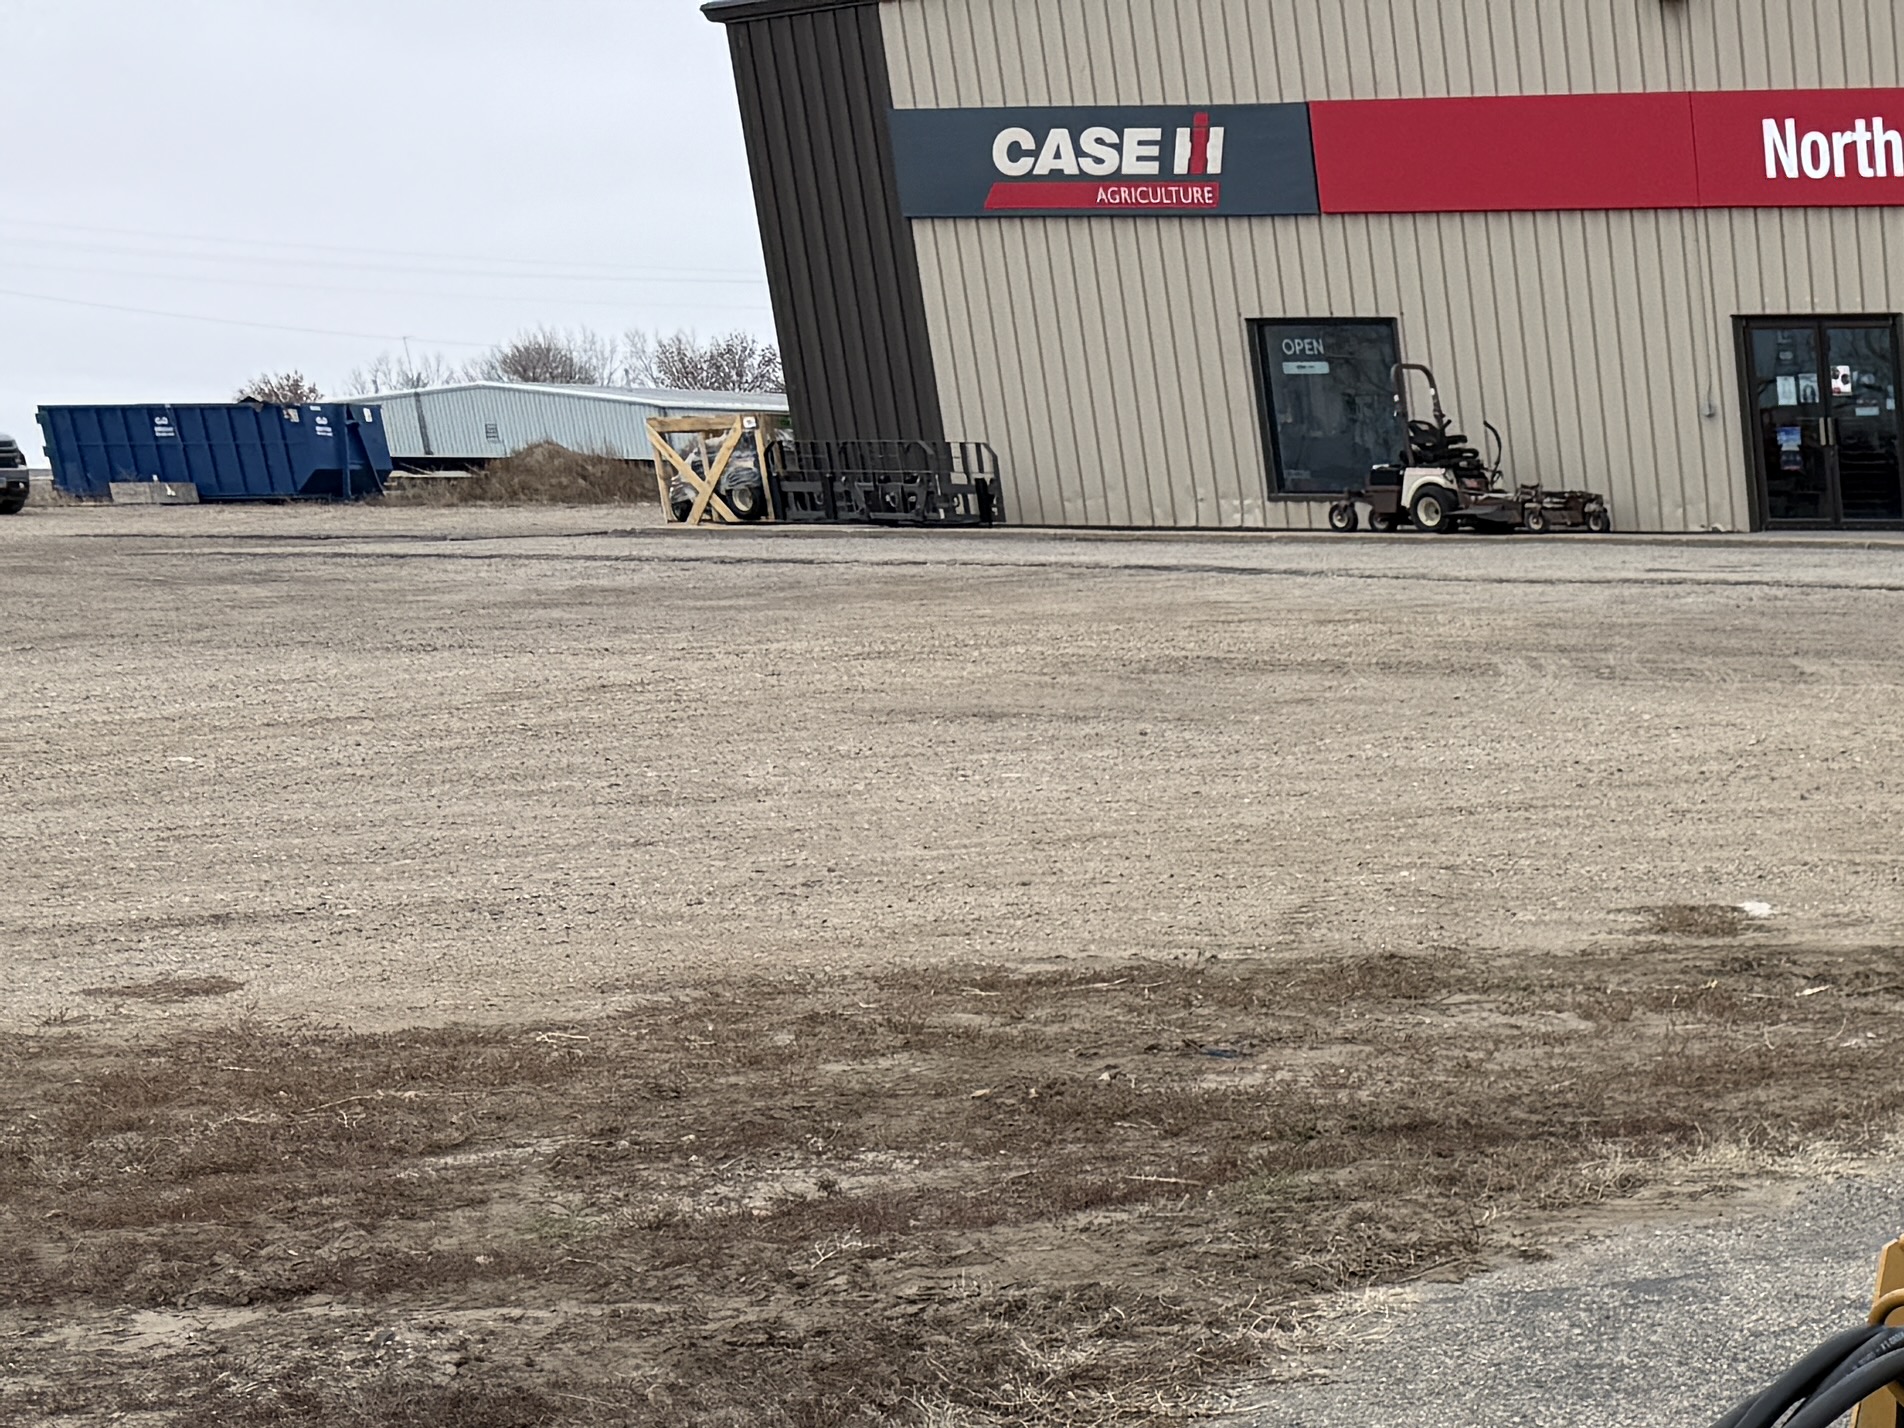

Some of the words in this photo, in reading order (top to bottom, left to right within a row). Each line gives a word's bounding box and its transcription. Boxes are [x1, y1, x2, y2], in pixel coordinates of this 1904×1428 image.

[992, 126, 1162, 176] CASE
[1096, 186, 1213, 204] AGRICULTURE
[1282, 339, 1324, 355] OPEN
